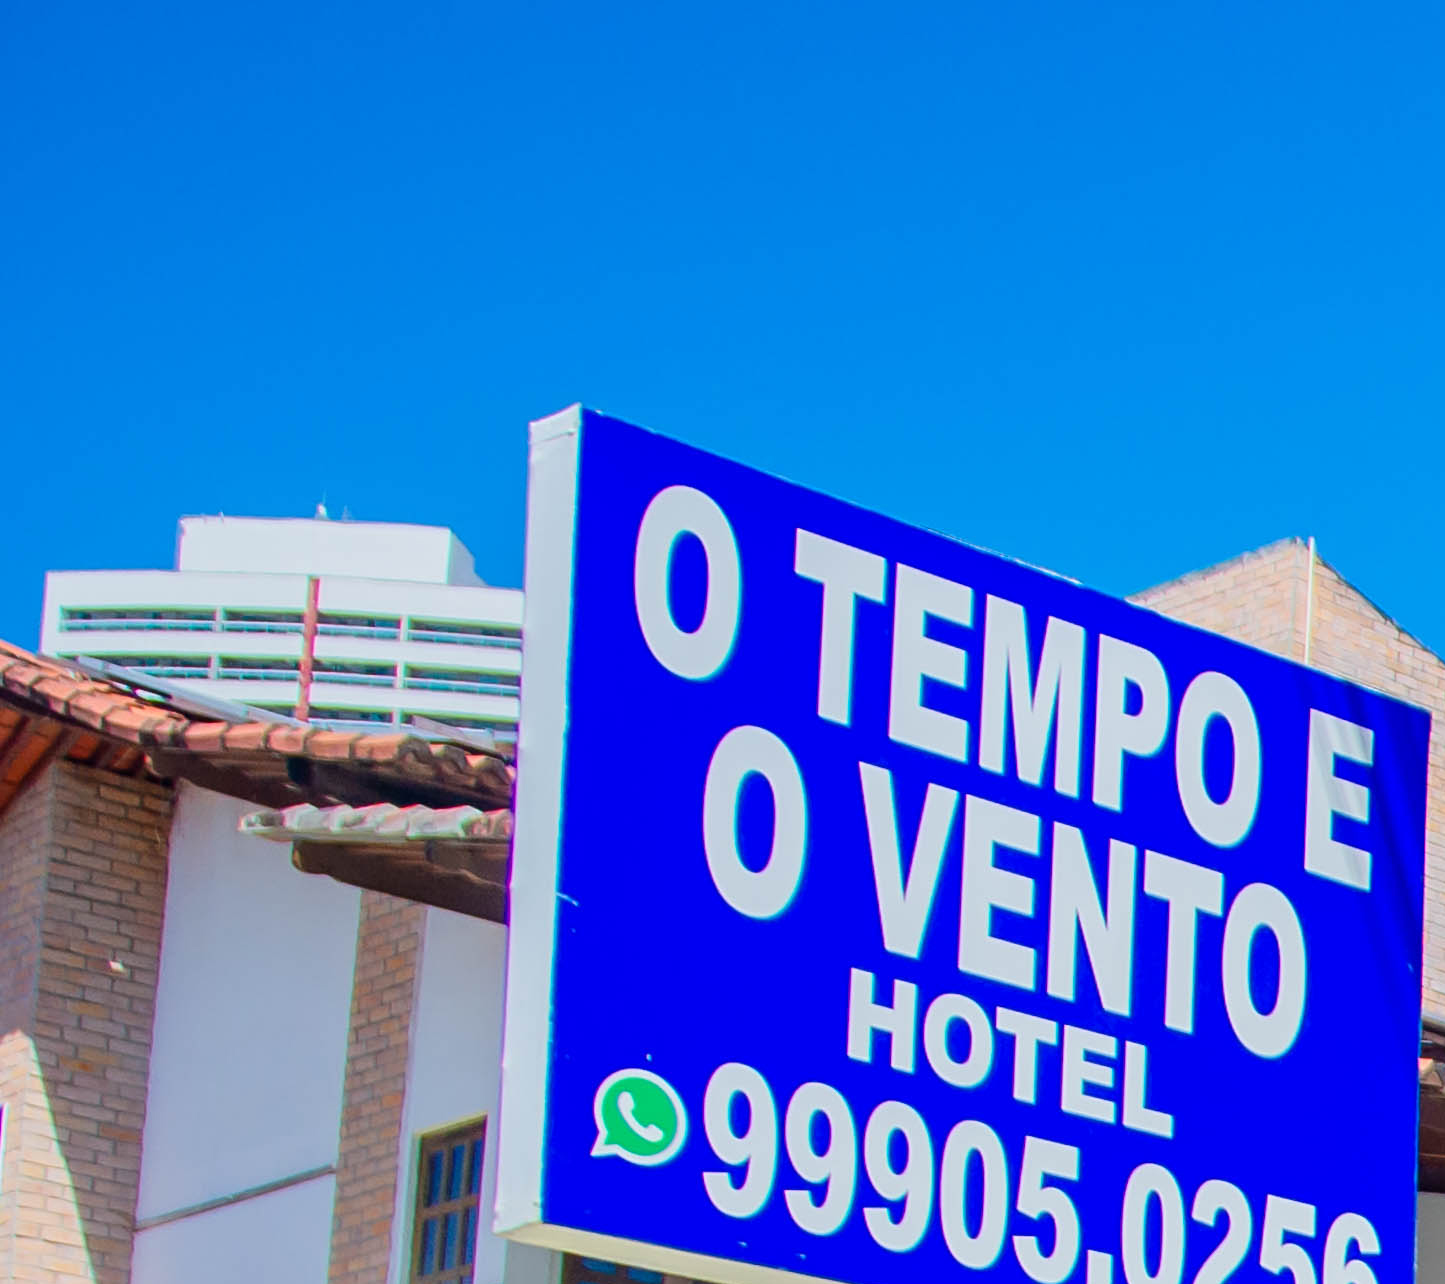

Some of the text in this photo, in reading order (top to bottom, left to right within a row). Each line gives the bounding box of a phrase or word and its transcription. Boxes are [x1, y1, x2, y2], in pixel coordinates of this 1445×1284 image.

[633, 484, 1375, 892] O TEMPO E
[702, 724, 1308, 1058] O VENTO
[846, 967, 1174, 1138] HOTEL
